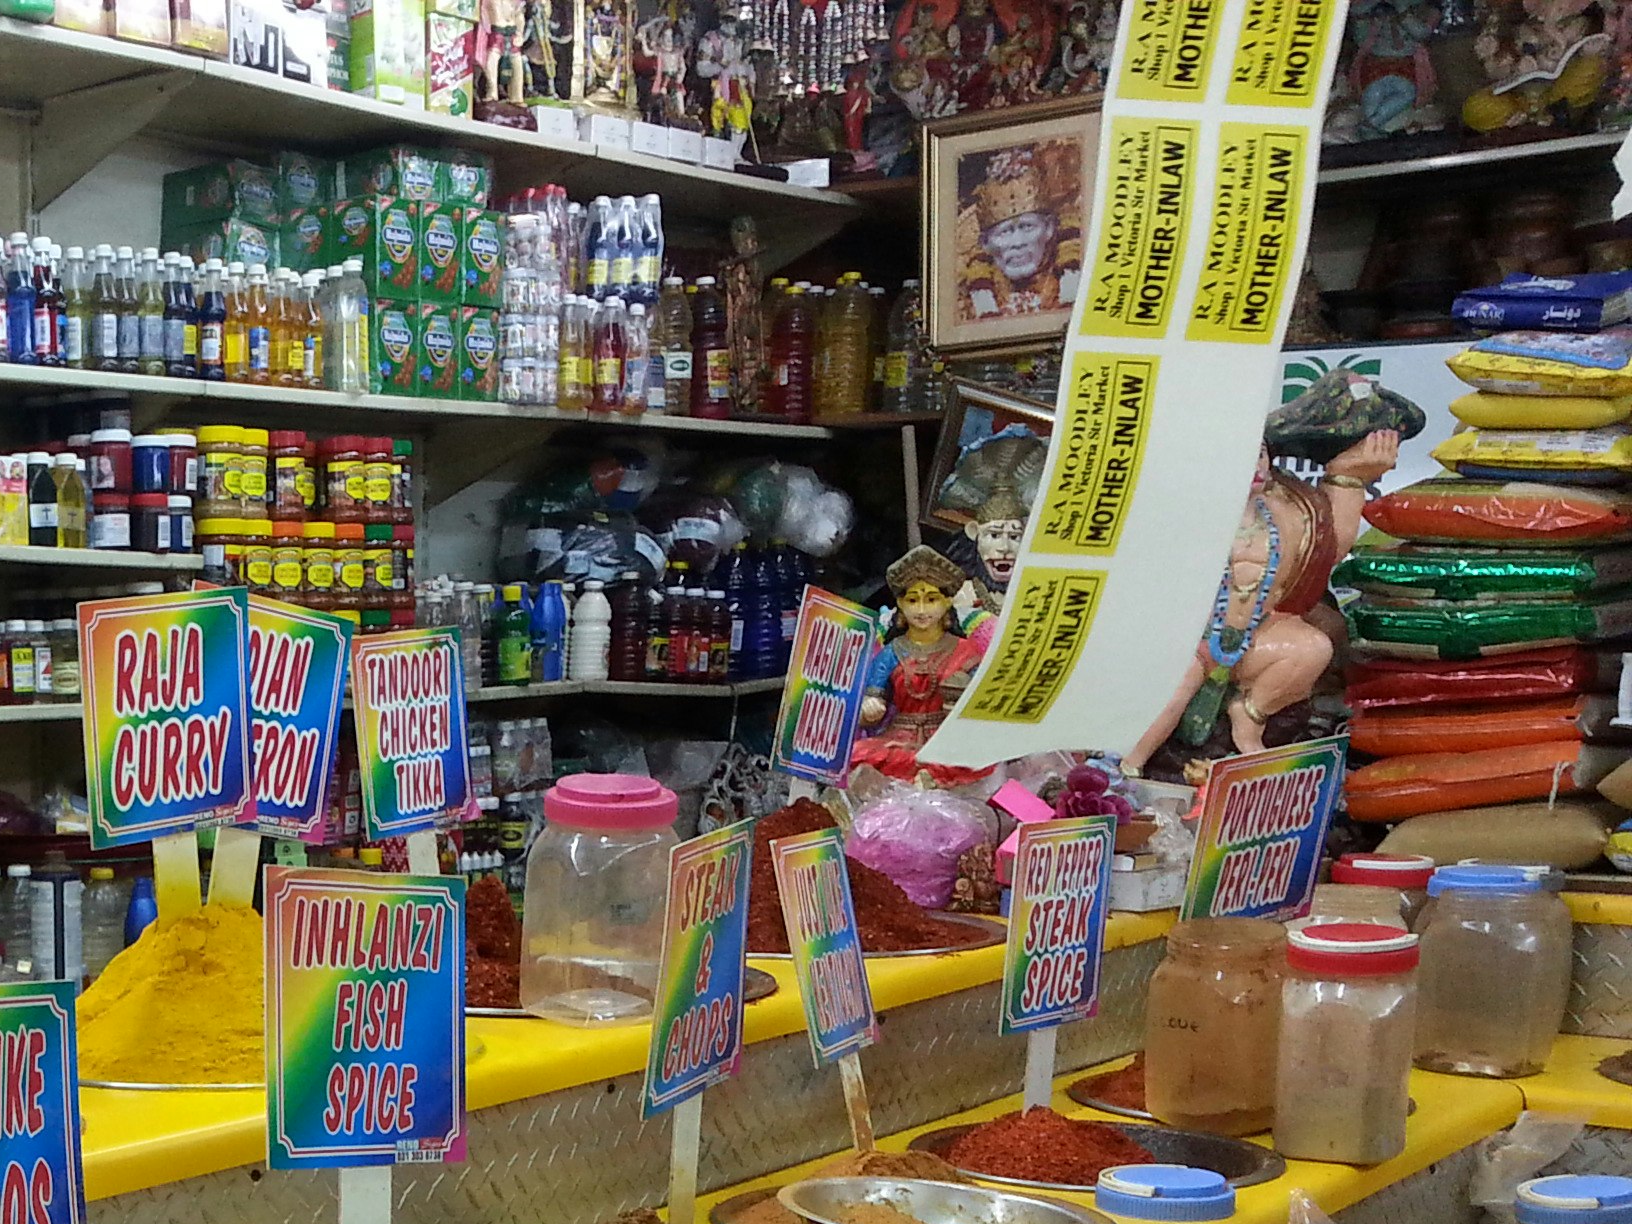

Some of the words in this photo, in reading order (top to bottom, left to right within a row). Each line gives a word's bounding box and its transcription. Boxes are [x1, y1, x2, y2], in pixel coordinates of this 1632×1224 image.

[1134, 131, 1150, 182] Market
[1240, 139, 1257, 190] Market
[1105, 133, 1134, 263] MOODLEY
[1132, 188, 1145, 209] Str
[1134, 140, 1186, 320] MOTHER-INLAW
[1208, 143, 1238, 271] MOODLEY
[1237, 197, 1250, 216] Str
[1120, 213, 1142, 268] Victoria
[1225, 218, 1248, 275] Victoria
[1239, 147, 1293, 326] MOTHER-INLAW
[1109, 284, 1131, 319] Shop
[1214, 291, 1235, 325] Shop
[1092, 366, 1111, 416] Market
[1058, 368, 1094, 492] MOODLEY
[1085, 374, 1144, 542] MOTHER-INLAW
[1088, 422, 1103, 440] Str
[1073, 444, 1098, 497] Victoria
[1060, 509, 1084, 541] Shop
[114, 622, 203, 716] RAJA
[366, 646, 451, 709] TANDOORI
[832, 628, 866, 693] WET
[1015, 588, 1090, 716] MOTHER-INLAW
[378, 700, 451, 761] CHICKEN
[793, 688, 846, 762] MASALA
[111, 706, 231, 811] CURRY
[394, 755, 445, 815] TIKKA
[1216, 764, 1326, 848] PORTUGUESE
[680, 848, 742, 933] STEAK
[1025, 842, 1054, 899] RED
[1053, 834, 1103, 896] PEPPER
[1210, 836, 1301, 917] PERI-PERI
[291, 896, 445, 973] INHLANZI
[1025, 890, 1095, 956] STEAK
[695, 931, 714, 996] &
[1021, 947, 1087, 1012] SPICE
[333, 978, 408, 1053] FISH
[662, 992, 733, 1083] CHOPS
[323, 1062, 418, 1134] SPICE
